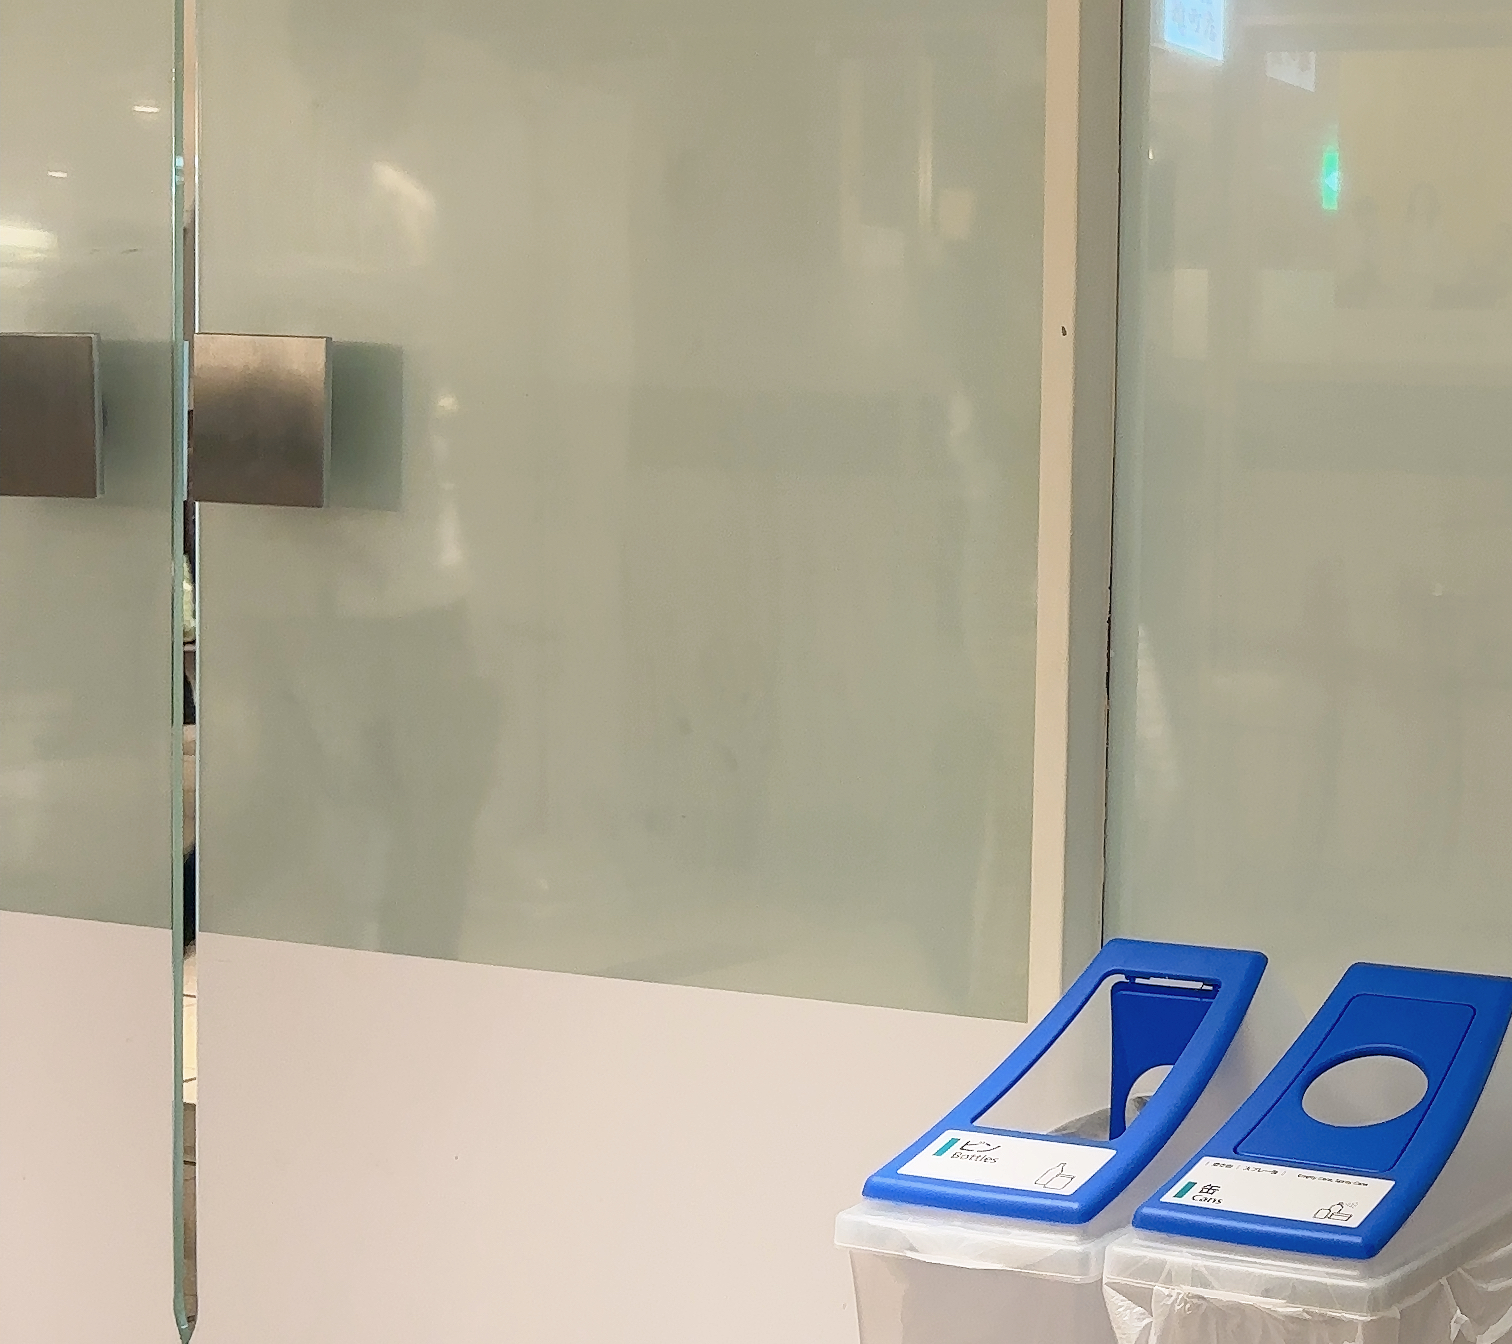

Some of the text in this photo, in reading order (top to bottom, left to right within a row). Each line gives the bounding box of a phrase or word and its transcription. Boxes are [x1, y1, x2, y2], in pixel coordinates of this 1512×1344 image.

[959, 1140, 1002, 1153] ビン
[950, 1151, 1000, 1164] Bottles
[1198, 1183, 1221, 1196] 缶
[1191, 1194, 1224, 1205] Cans
